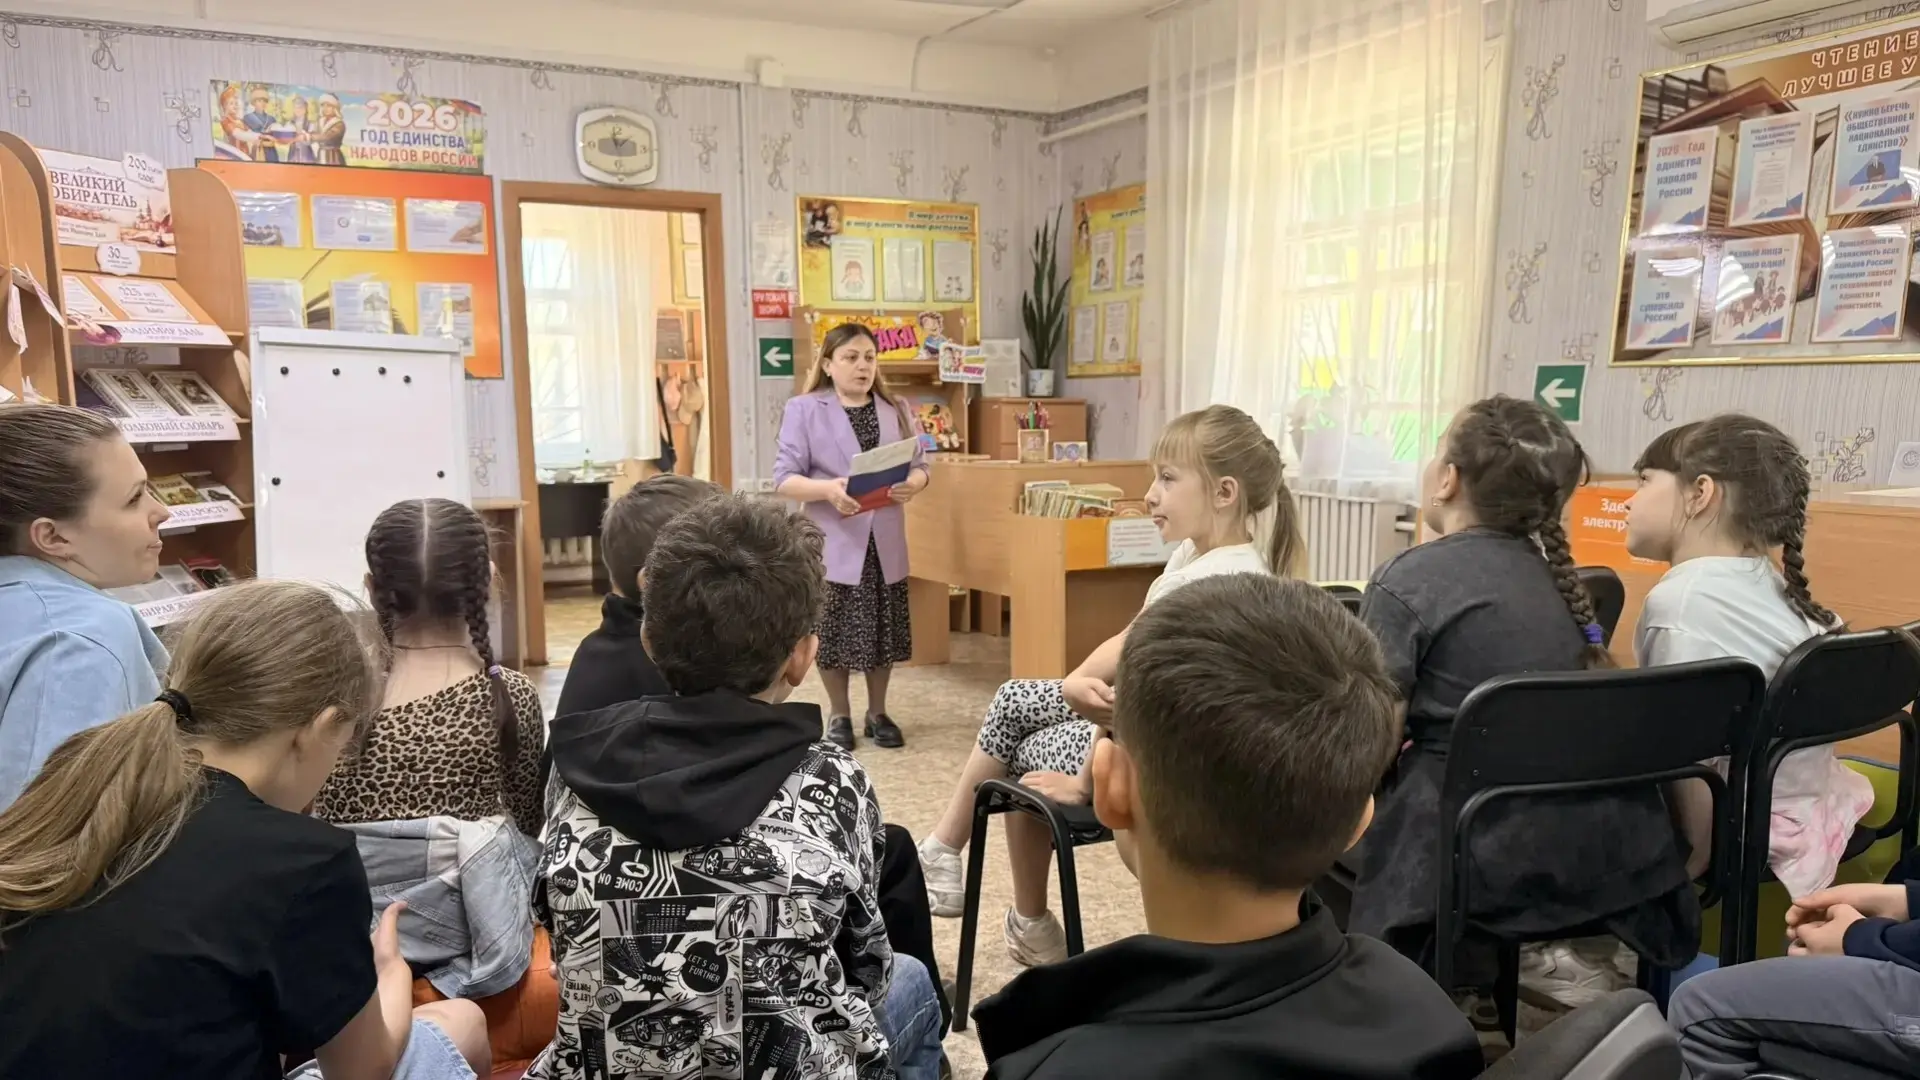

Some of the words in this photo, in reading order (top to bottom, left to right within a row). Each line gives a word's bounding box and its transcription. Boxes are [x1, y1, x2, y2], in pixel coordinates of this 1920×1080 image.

[1812, 30, 1918, 68] ЧТЕНИЕ
[1781, 60, 1893, 98] ЛУЧШЕЕ
[1901, 55, 1917, 75] У
[365, 99, 459, 132] 2026
[1846, 113, 1907, 132] ОБЩЕСТВЕННОЕ
[1909, 112, 1915, 121] И
[360, 129, 389, 145] ГОД
[393, 131, 465, 148] ЕДИНСТВА
[1848, 124, 1910, 143] НАЦИОНАЛЬНОЕ
[350, 147, 418, 163] НАРОДОВ
[423, 150, 479, 168] РОССИИ
[1656, 144, 1680, 157] 2026
[128, 155, 148, 171] 200
[50, 170, 126, 193] ВЕЛИКИЙ
[52, 185, 138, 208] ОБИРАТЕЛЬ
[107, 245, 121, 259] 30
[180, 421, 224, 431] СЛОВАРЬ
[176, 506, 228, 518] МУДРОСТЬ
[598, 873, 611, 885] ON
[614, 876, 643, 892] COME
[688, 954, 708, 967] LET'S
[709, 962, 720, 971] GO
[688, 965, 721, 984] FURTHER
[574, 992, 592, 1003] LET'S
